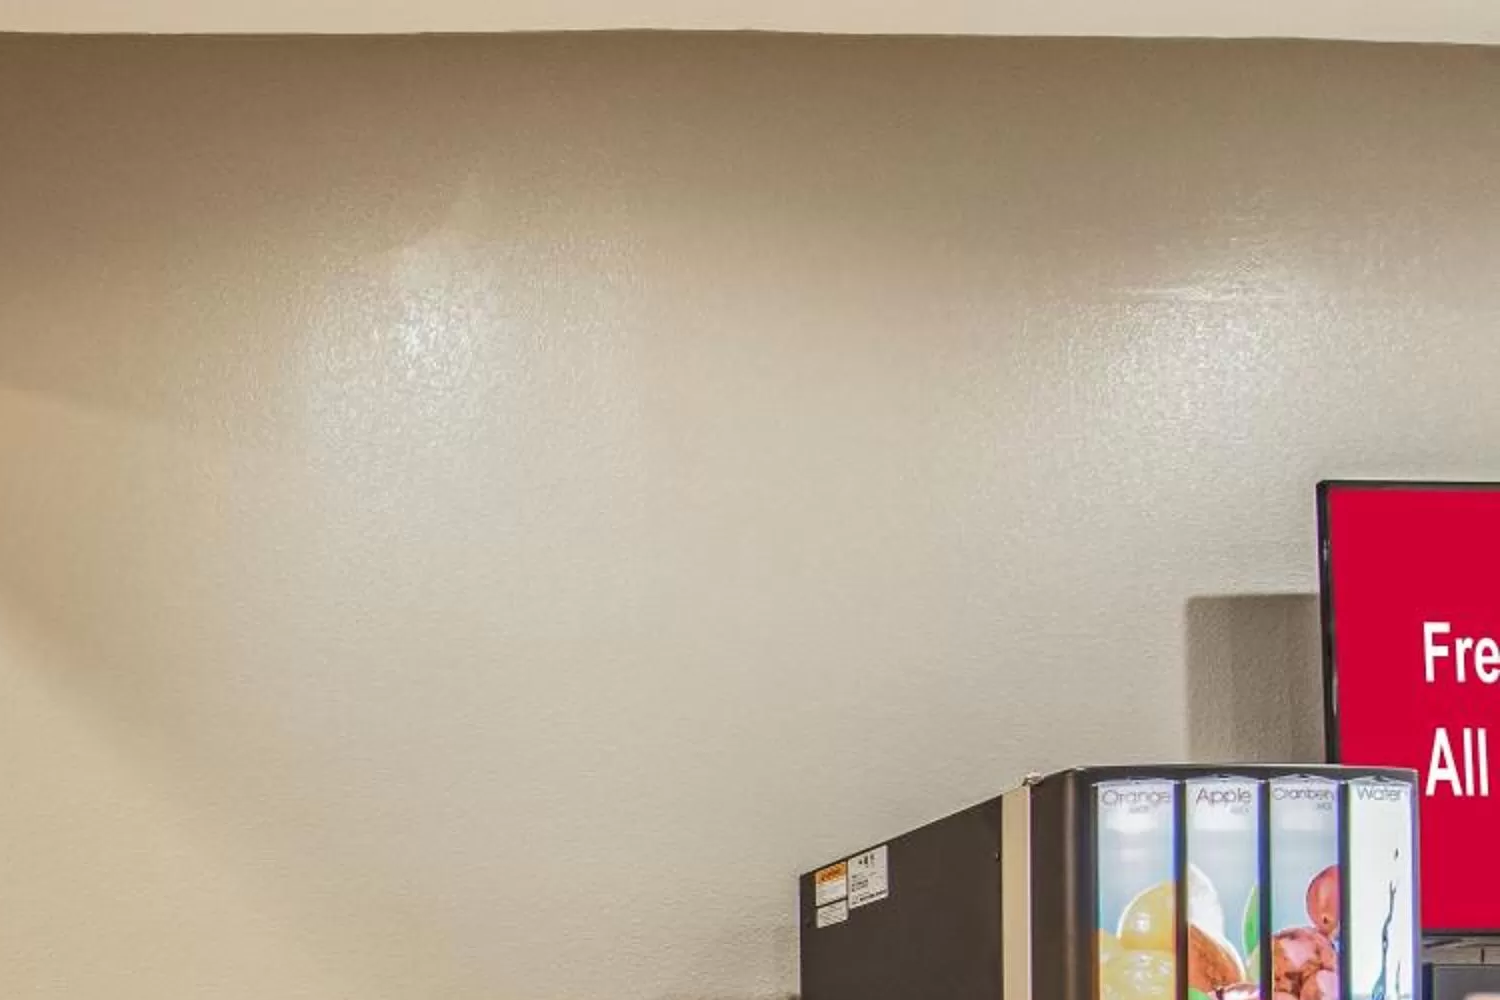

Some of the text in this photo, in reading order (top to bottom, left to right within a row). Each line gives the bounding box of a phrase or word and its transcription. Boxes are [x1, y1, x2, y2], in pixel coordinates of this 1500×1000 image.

[1423, 620, 1500, 684] Fre
[1425, 726, 1490, 797] All
[1102, 788, 1171, 808] Orange
[1195, 787, 1253, 808] Apple
